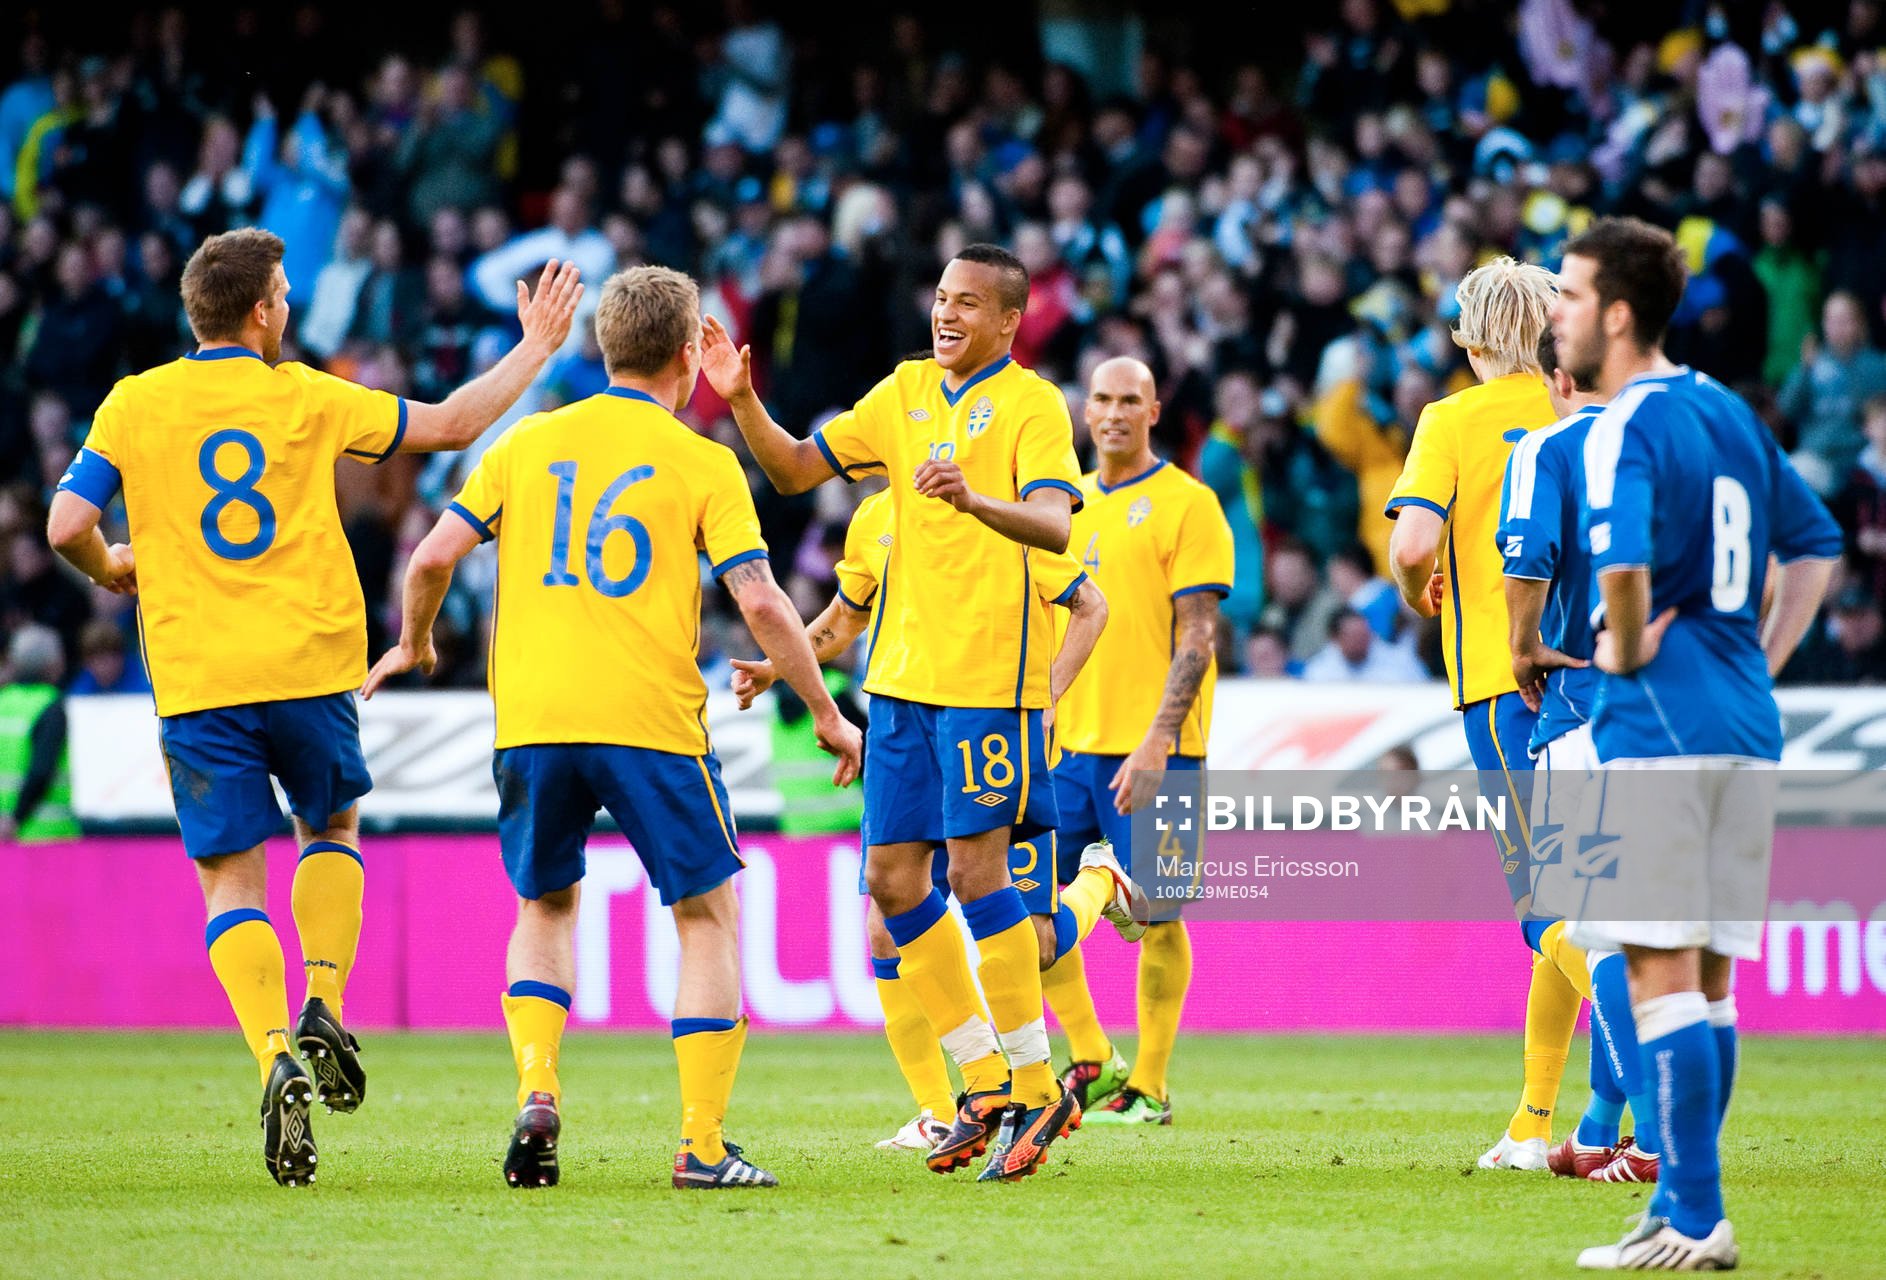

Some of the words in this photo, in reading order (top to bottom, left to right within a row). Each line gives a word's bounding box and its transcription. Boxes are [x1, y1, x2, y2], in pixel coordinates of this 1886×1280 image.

[199, 428, 276, 560] 8
[543, 460, 656, 598] 16
[1083, 531, 1100, 575] 4
[957, 733, 1015, 793] 18
